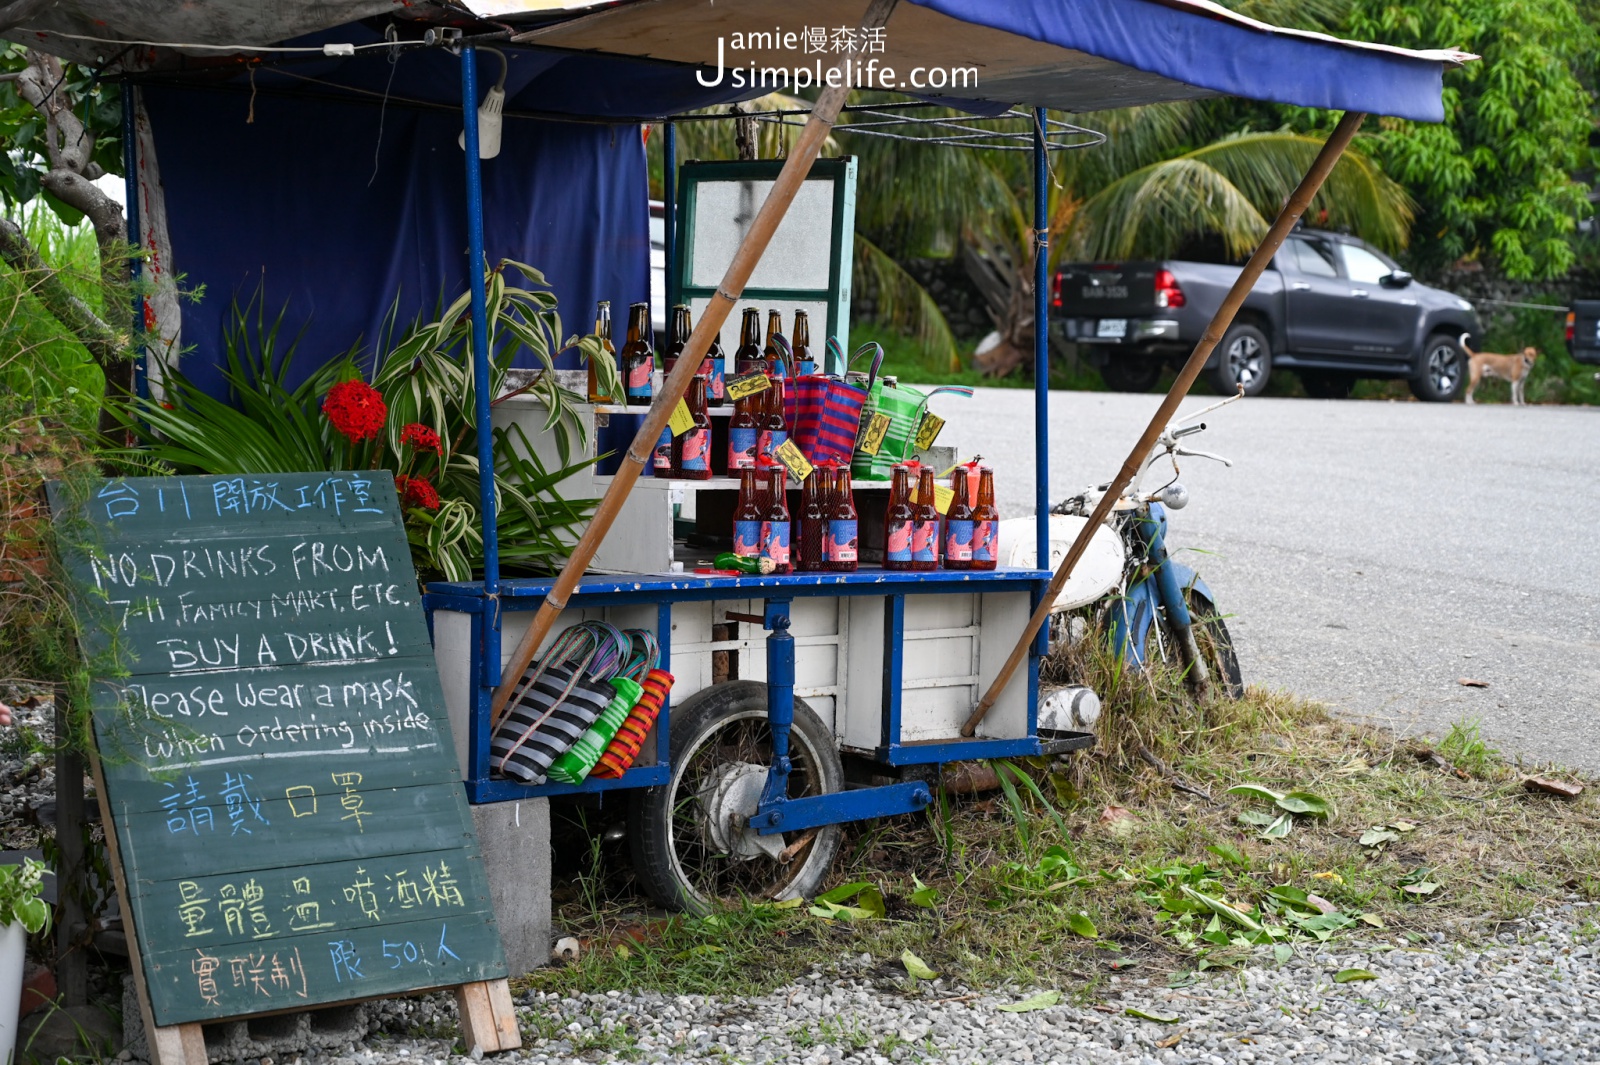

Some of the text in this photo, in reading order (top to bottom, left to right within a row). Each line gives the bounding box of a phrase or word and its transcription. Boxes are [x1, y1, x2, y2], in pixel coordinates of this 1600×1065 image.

[212, 474, 384, 517] 開放工作室
[90, 542, 390, 588] NO DRINKS FROM
[351, 583, 410, 611] ETC.
[156, 633, 240, 669] BUY
[258, 633, 277, 665] A
[316, 684, 335, 708] a
[343, 672, 419, 710] mask
[357, 704, 431, 738] inside
